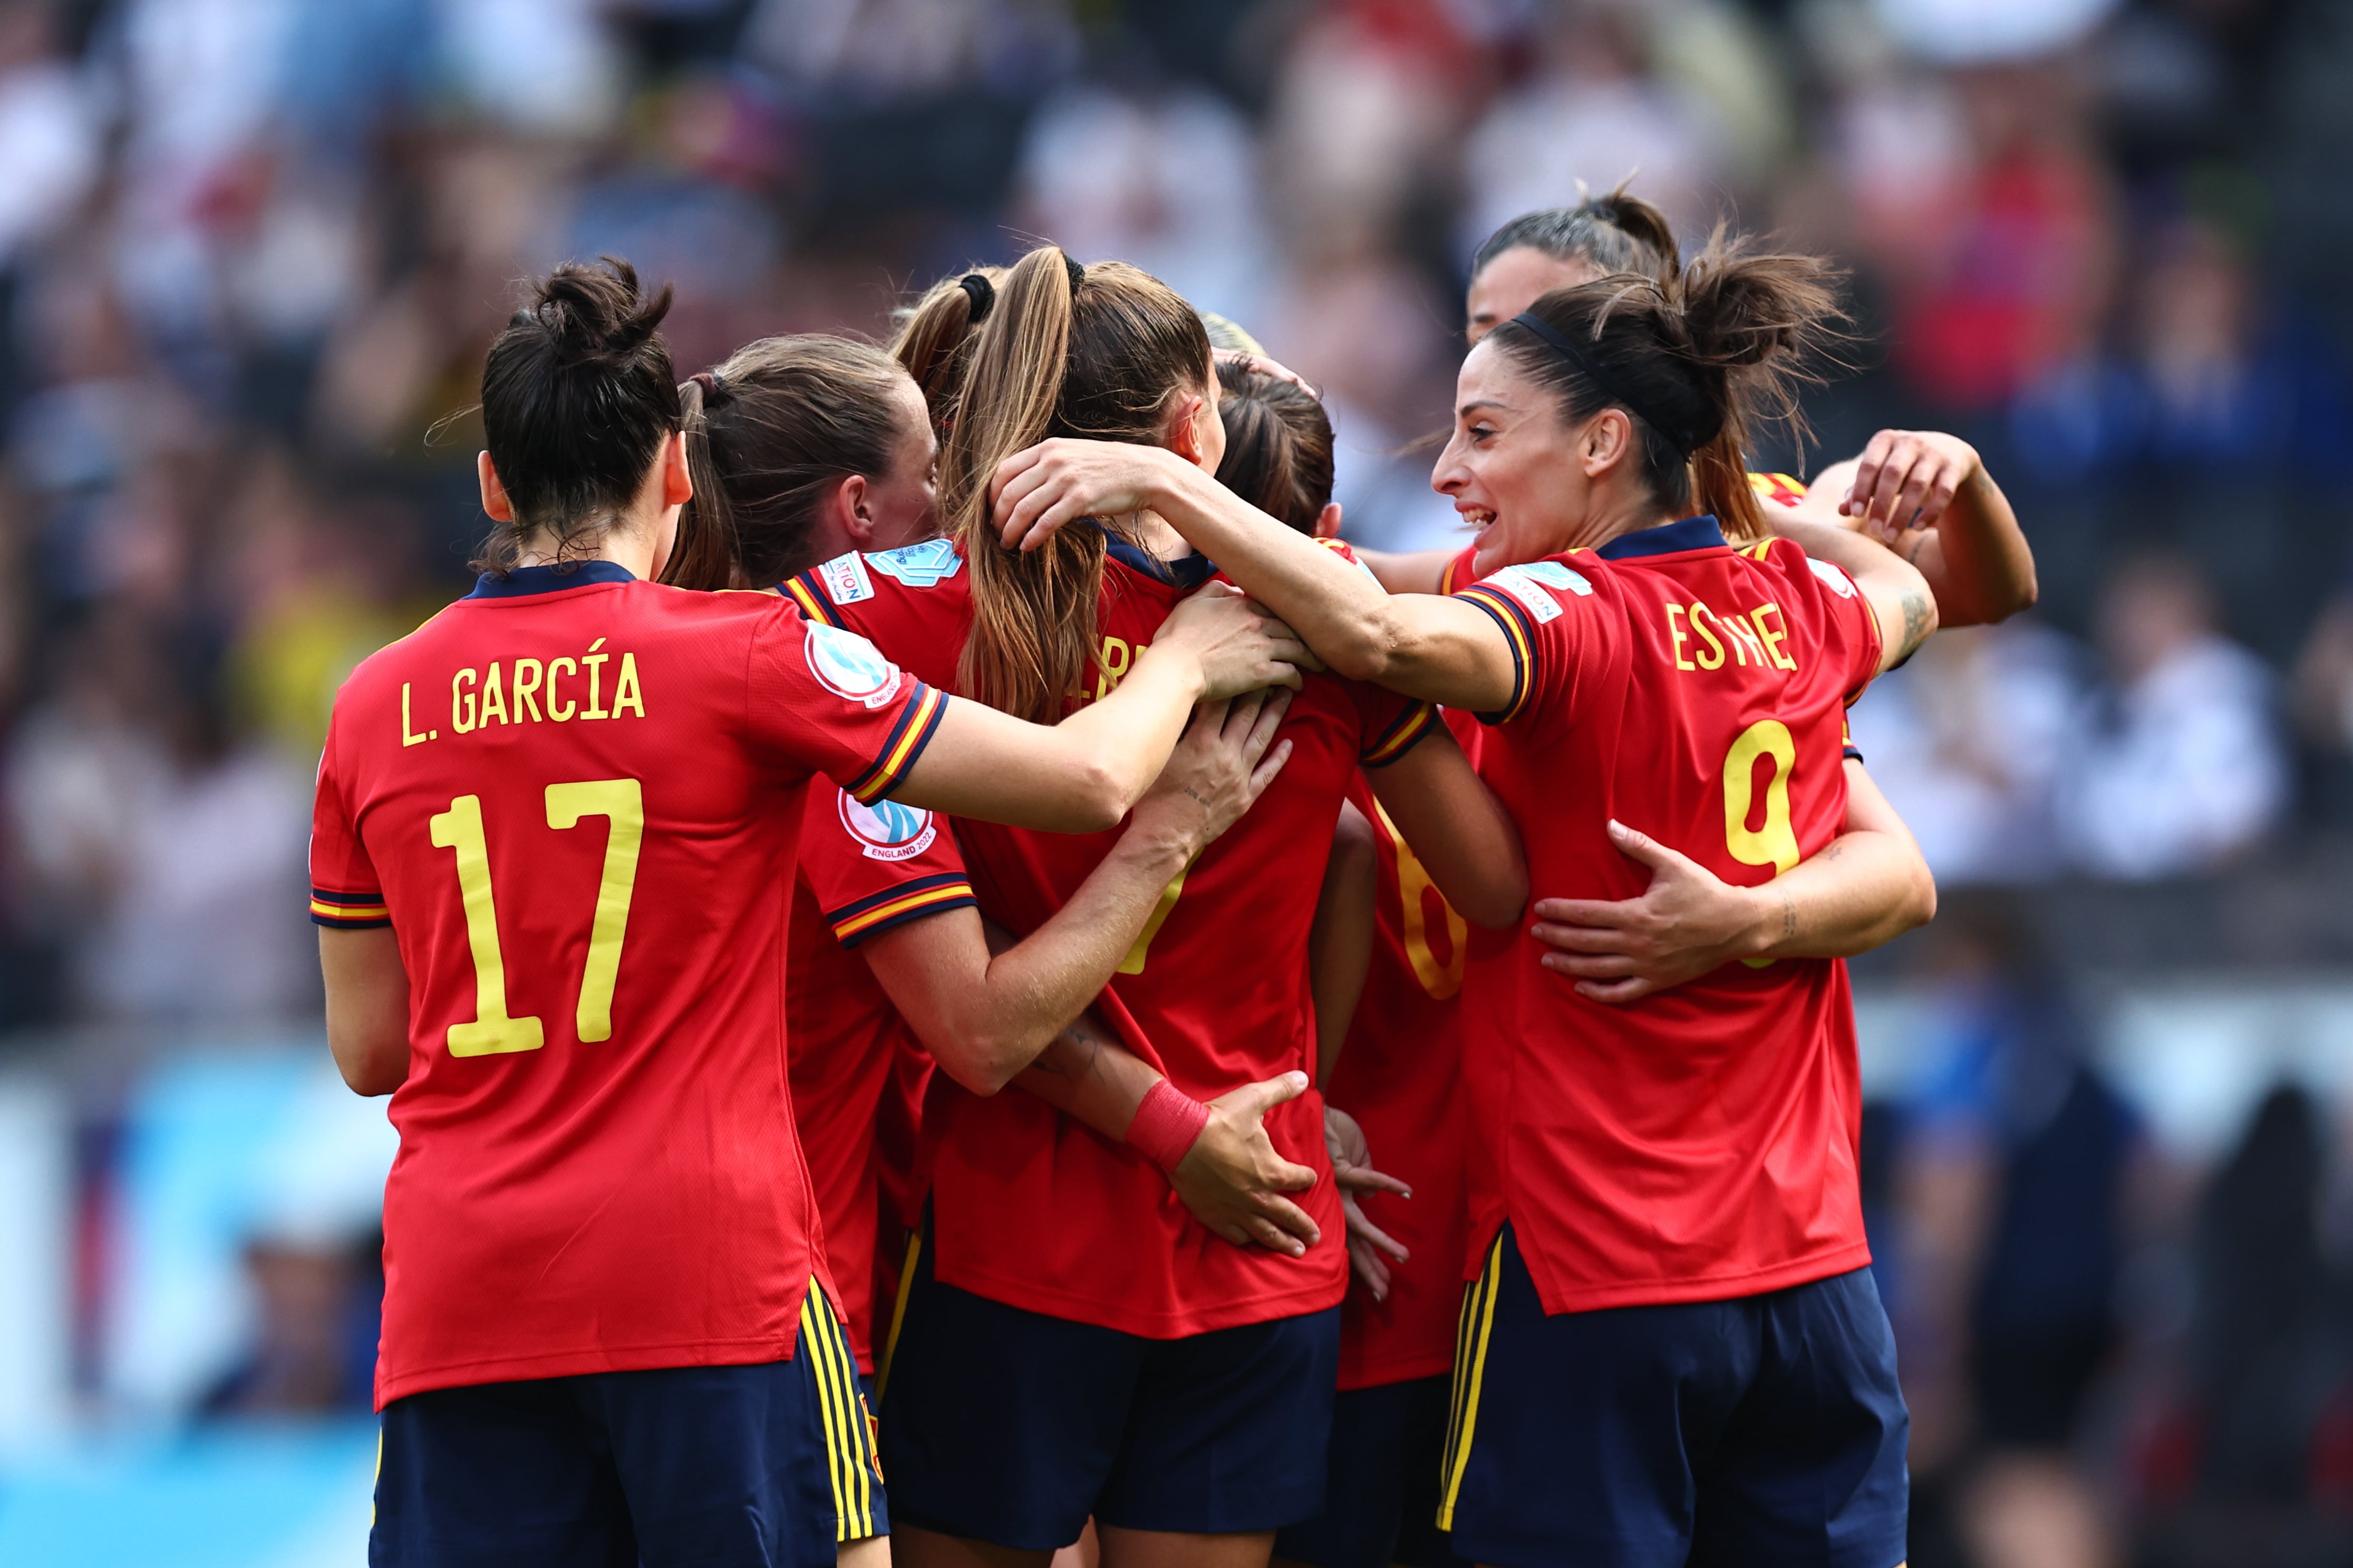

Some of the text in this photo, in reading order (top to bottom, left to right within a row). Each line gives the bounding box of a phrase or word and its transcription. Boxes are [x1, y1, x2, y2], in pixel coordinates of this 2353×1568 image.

[1509, 581, 1554, 616] ATION
[402, 637, 645, 747] L. GARCÍA
[872, 832, 932, 858] ENGLAND 2022
[1723, 719, 1800, 877] 9
[429, 778, 644, 1058] 17
